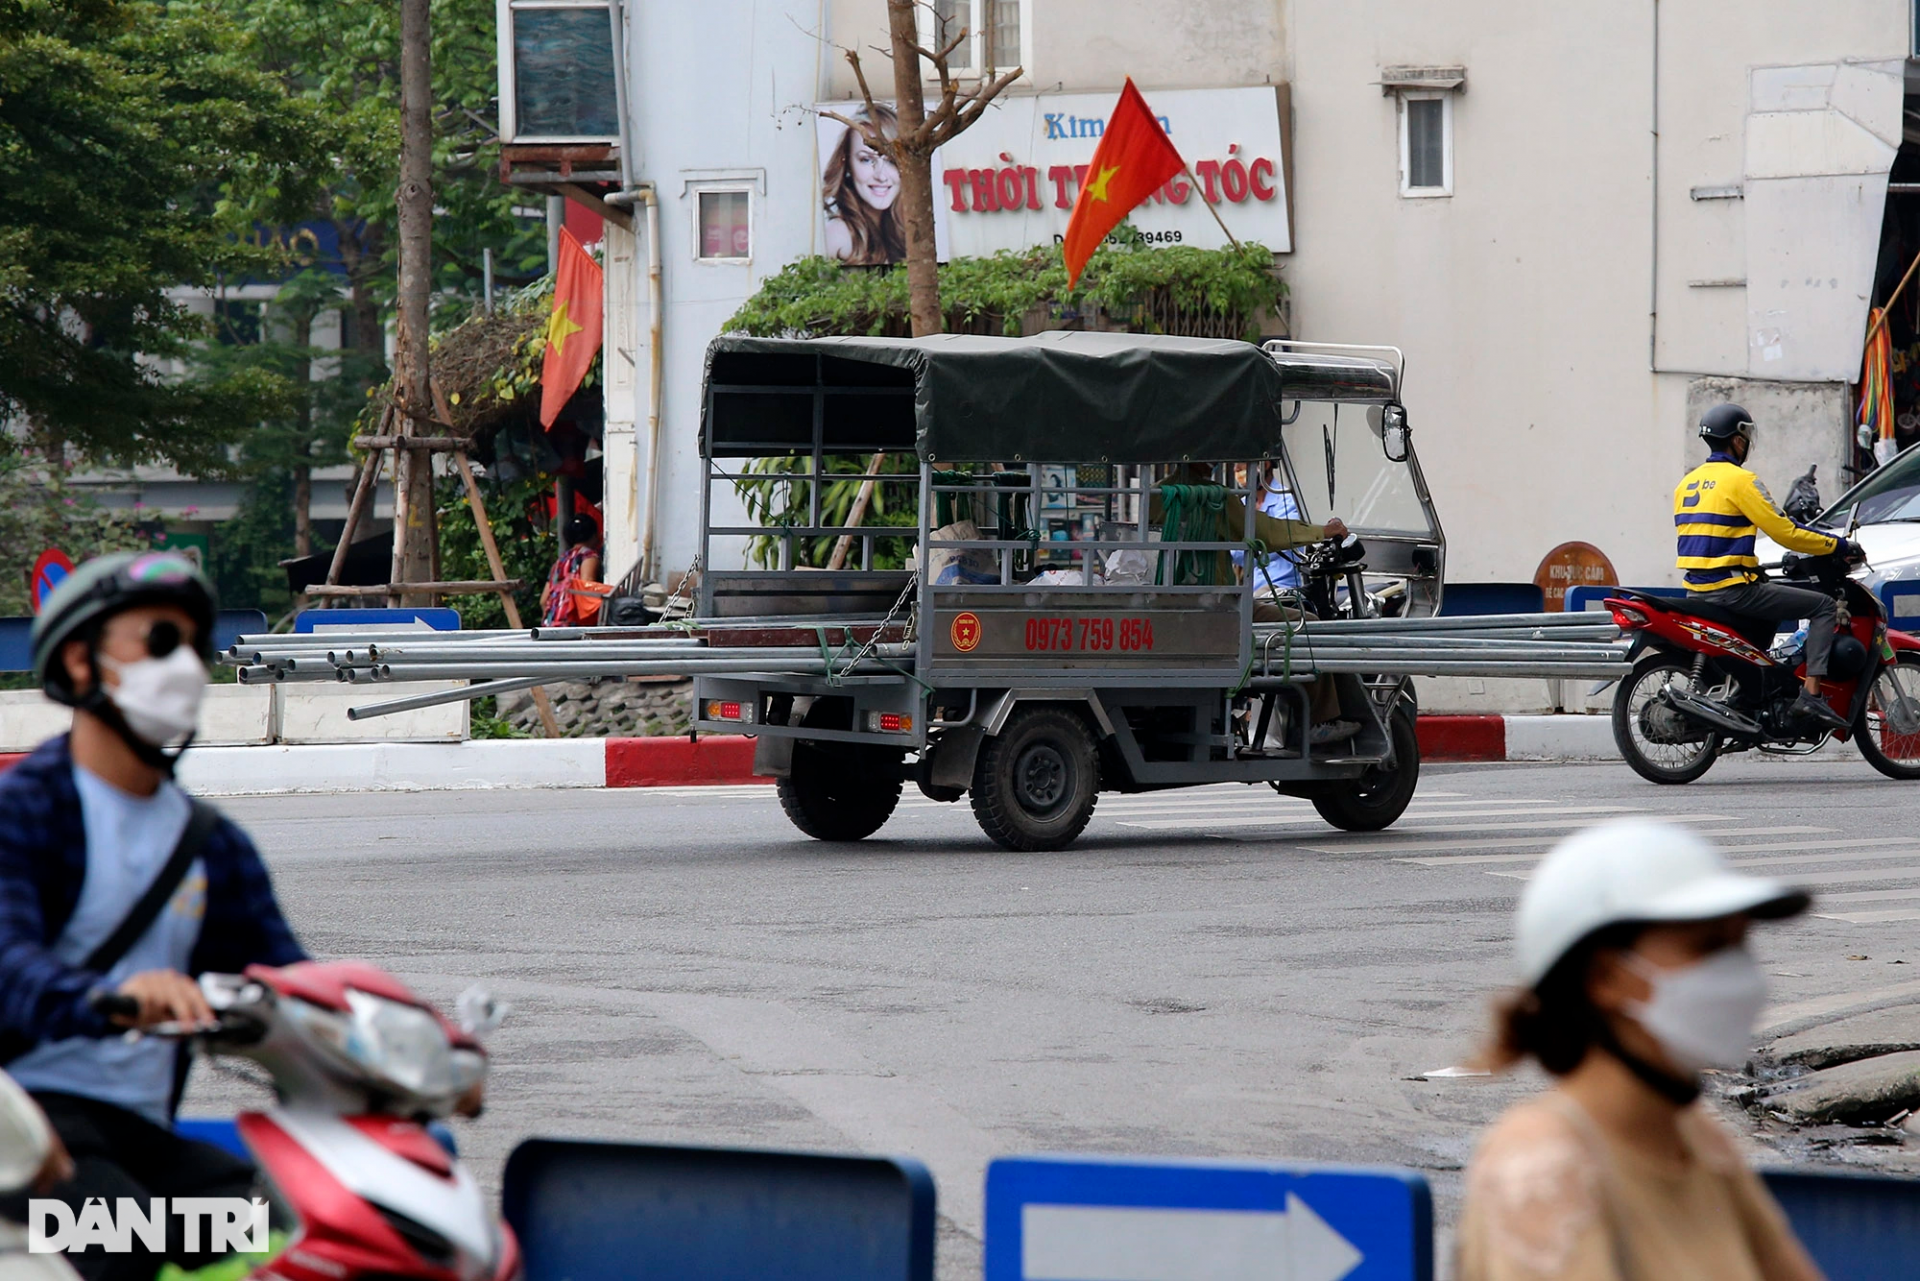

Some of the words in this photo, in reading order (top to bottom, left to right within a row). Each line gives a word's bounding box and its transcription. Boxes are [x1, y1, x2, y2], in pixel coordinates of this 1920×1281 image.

[1044, 113, 1105, 139] Kim
[943, 152, 1042, 212] THỜI
[1196, 143, 1275, 204] TÓC
[1702, 479, 1716, 490] be
[1025, 618, 1073, 651] 0973
[1079, 618, 1114, 651] 759
[1119, 618, 1153, 651] 854
